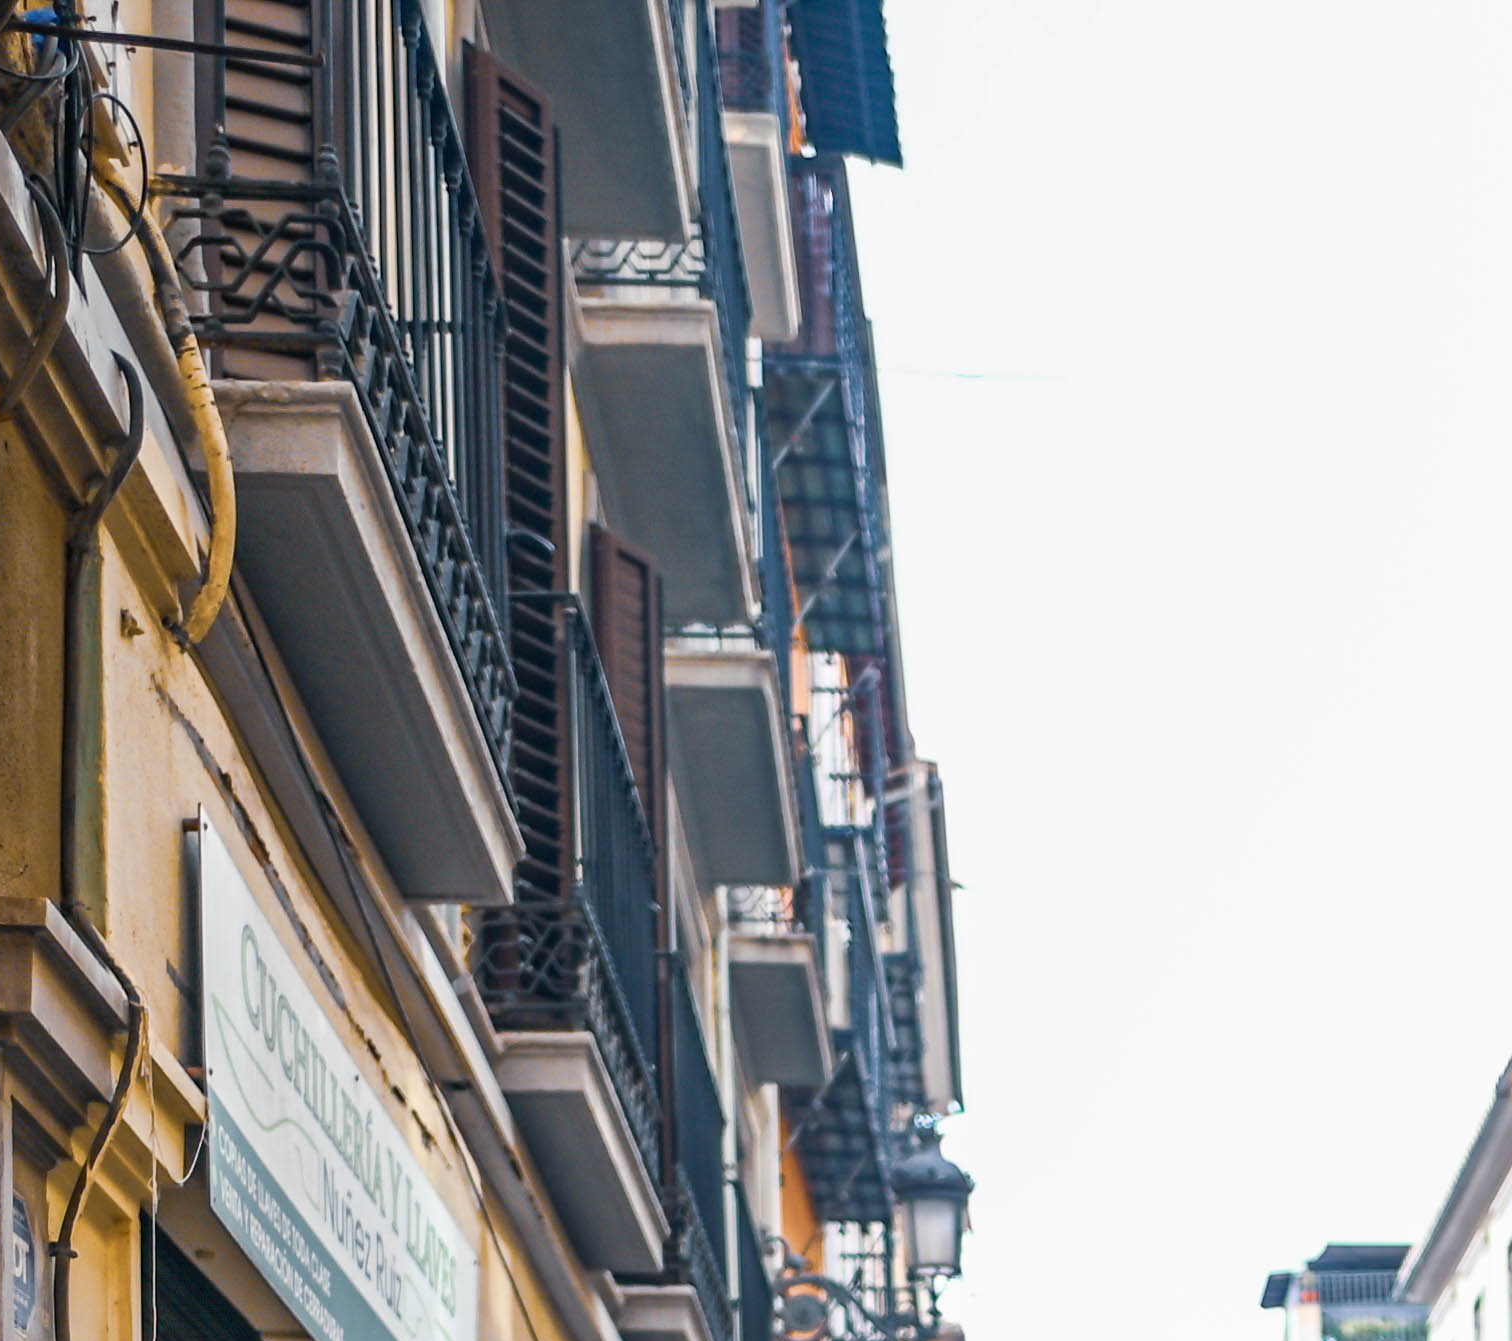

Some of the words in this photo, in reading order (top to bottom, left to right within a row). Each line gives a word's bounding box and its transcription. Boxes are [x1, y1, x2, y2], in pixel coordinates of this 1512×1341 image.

[241, 924, 387, 1218] CUCHILLERÍA
[387, 1147, 403, 1236] Y
[405, 1174, 457, 1318] LLAVES
[376, 1245, 403, 1321] Ruiz
